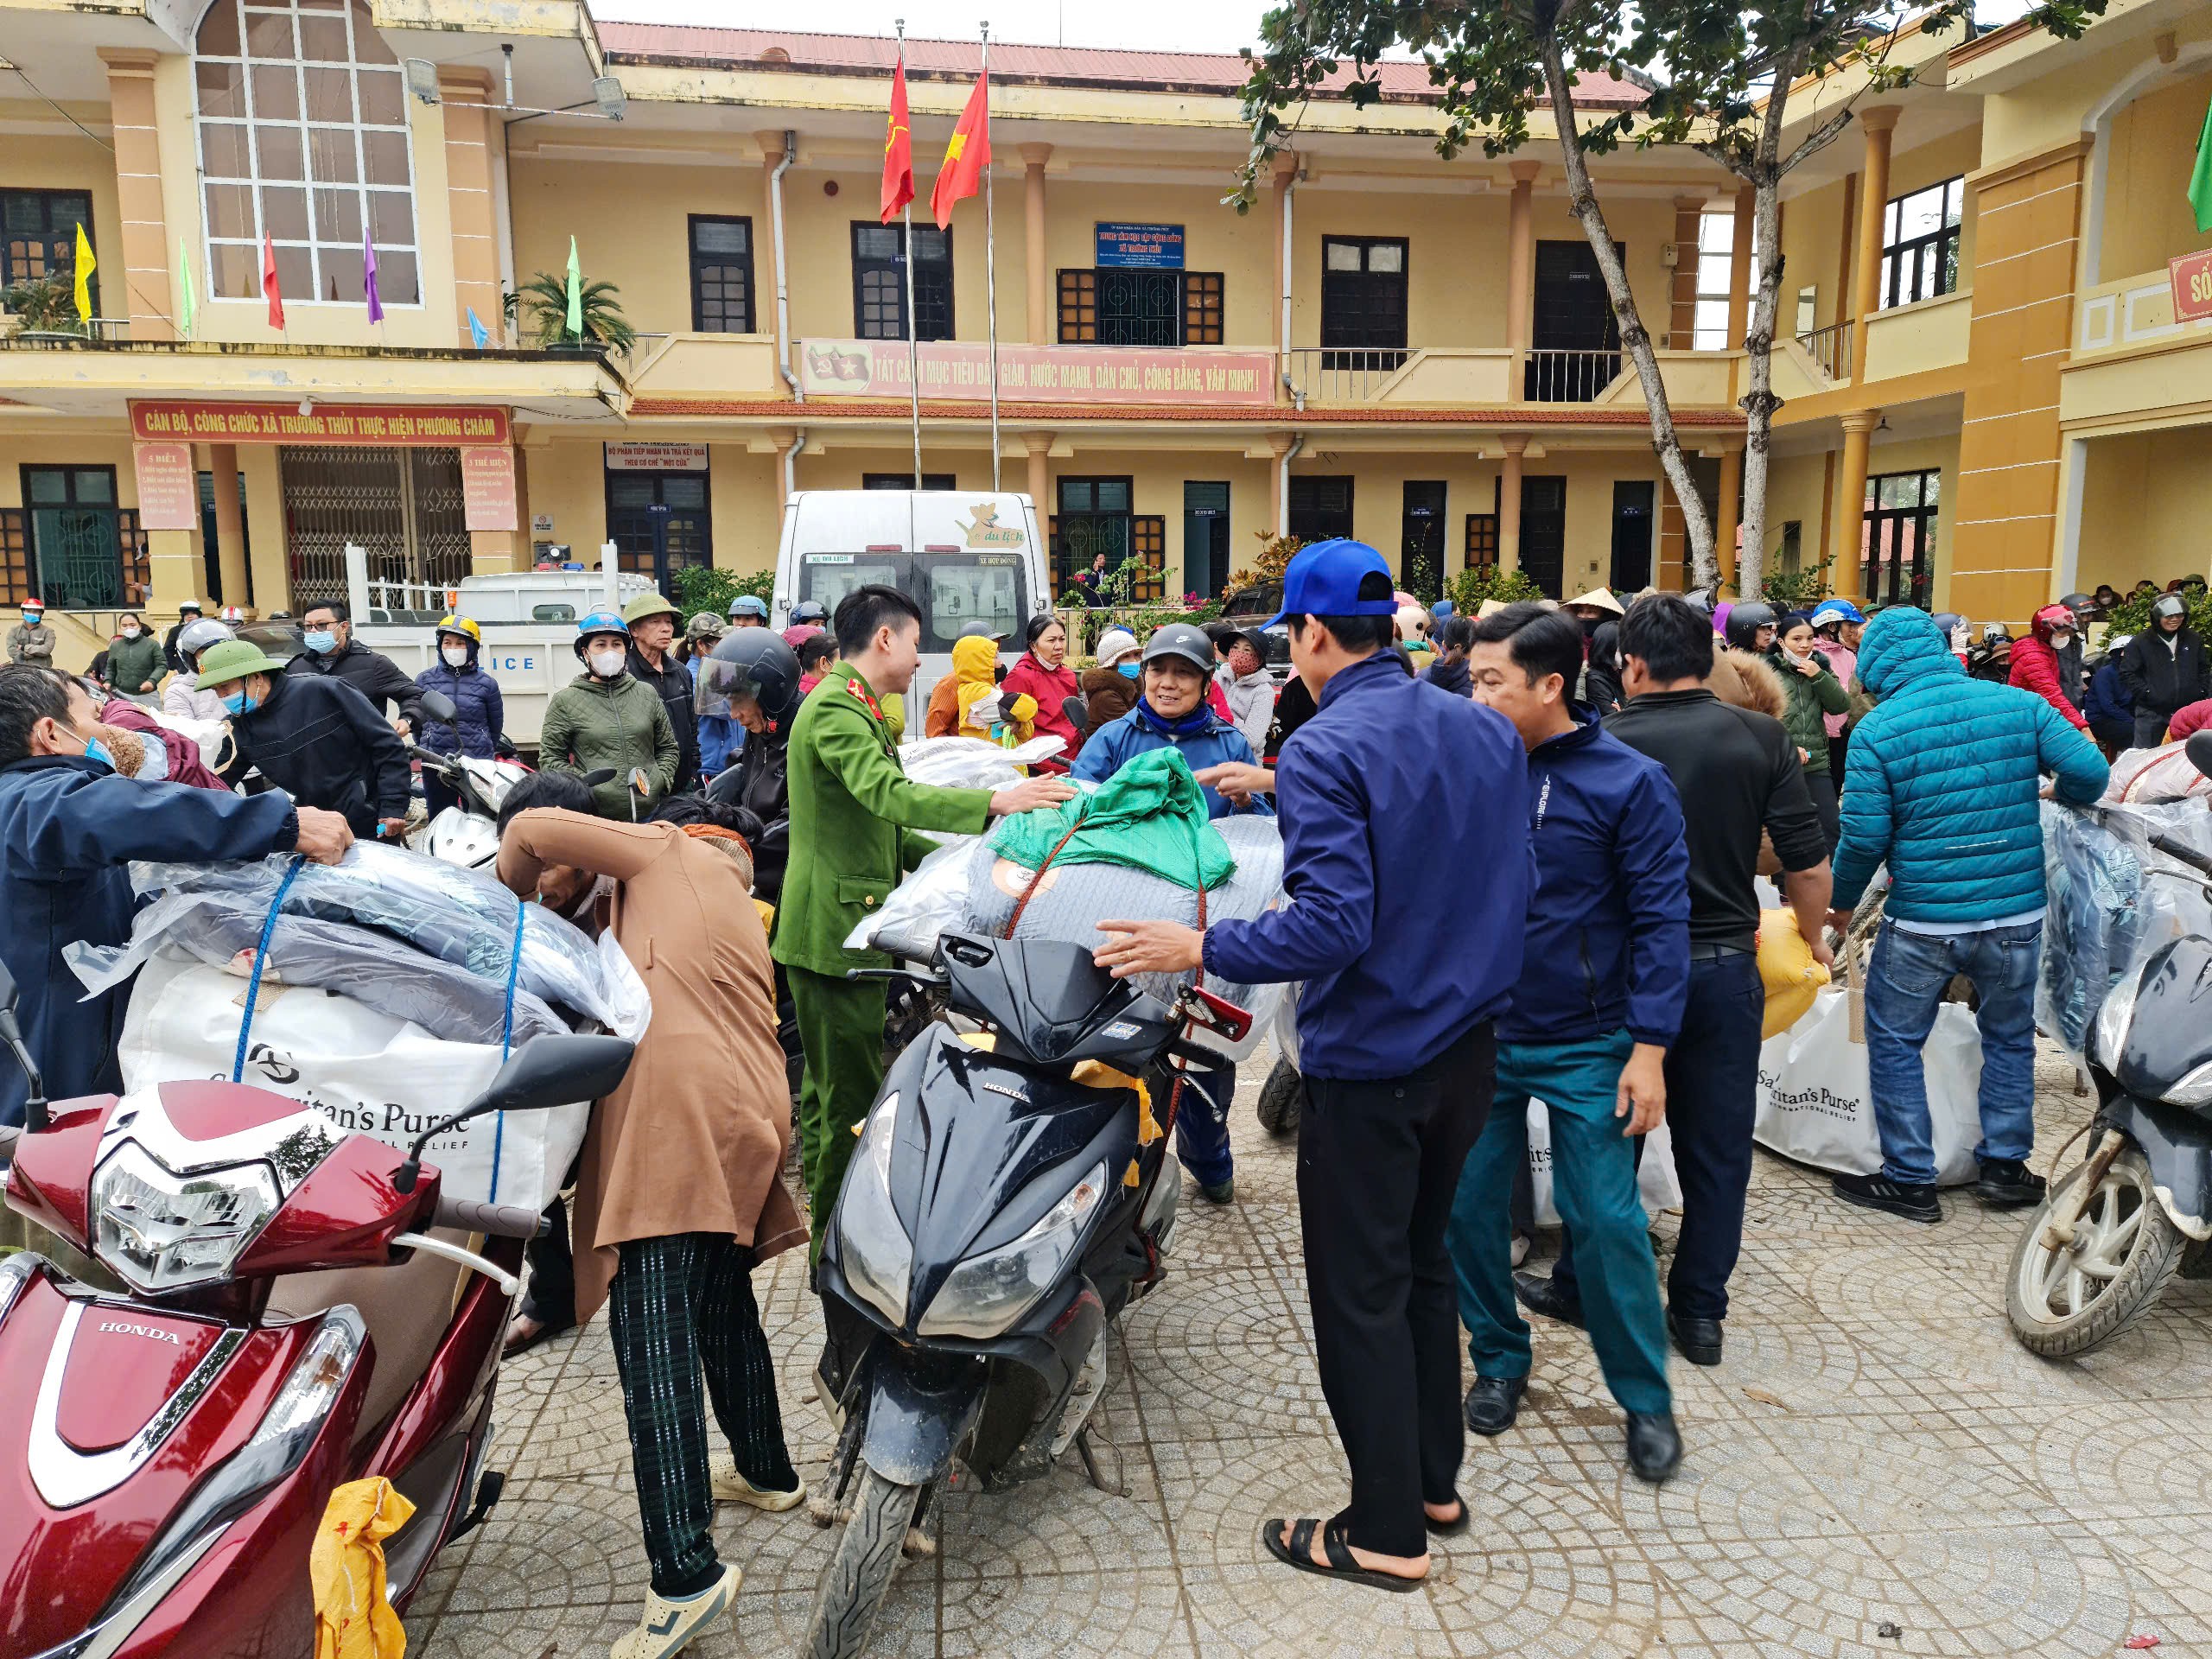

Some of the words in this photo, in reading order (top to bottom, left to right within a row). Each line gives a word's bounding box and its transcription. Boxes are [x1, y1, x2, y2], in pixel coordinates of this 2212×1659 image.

[875, 351, 893, 382] TẤT
[926, 360, 949, 389] MỤC
[952, 357, 975, 385] TIÊU
[976, 357, 991, 386] DÂ
[1001, 359, 1027, 389] GIÀU,
[1060, 364, 1093, 393] MẠNH,
[1096, 361, 1116, 389] DÂN
[1119, 359, 1142, 392] CHỦ,
[1145, 363, 1171, 391] CÔNG
[1173, 359, 1203, 393] BẰNG,
[1205, 365, 1225, 391] VĂN
[1228, 369, 1254, 392] MINH
[145, 410, 170, 431] CÁN
[172, 410, 193, 435] BỘ,
[194, 410, 226, 432] CÔNG
[228, 410, 259, 433] CHỨC
[262, 411, 278, 433] XÃ
[326, 410, 354, 435] THỦY
[357, 415, 385, 439] THỰC
[388, 414, 415, 439] HIỆN
[416, 416, 461, 435] PHƯƠNG
[463, 414, 496, 435] CHÂM
[982, 1082, 1031, 1103] HONDA
[98, 1322, 180, 1345] HONDA
